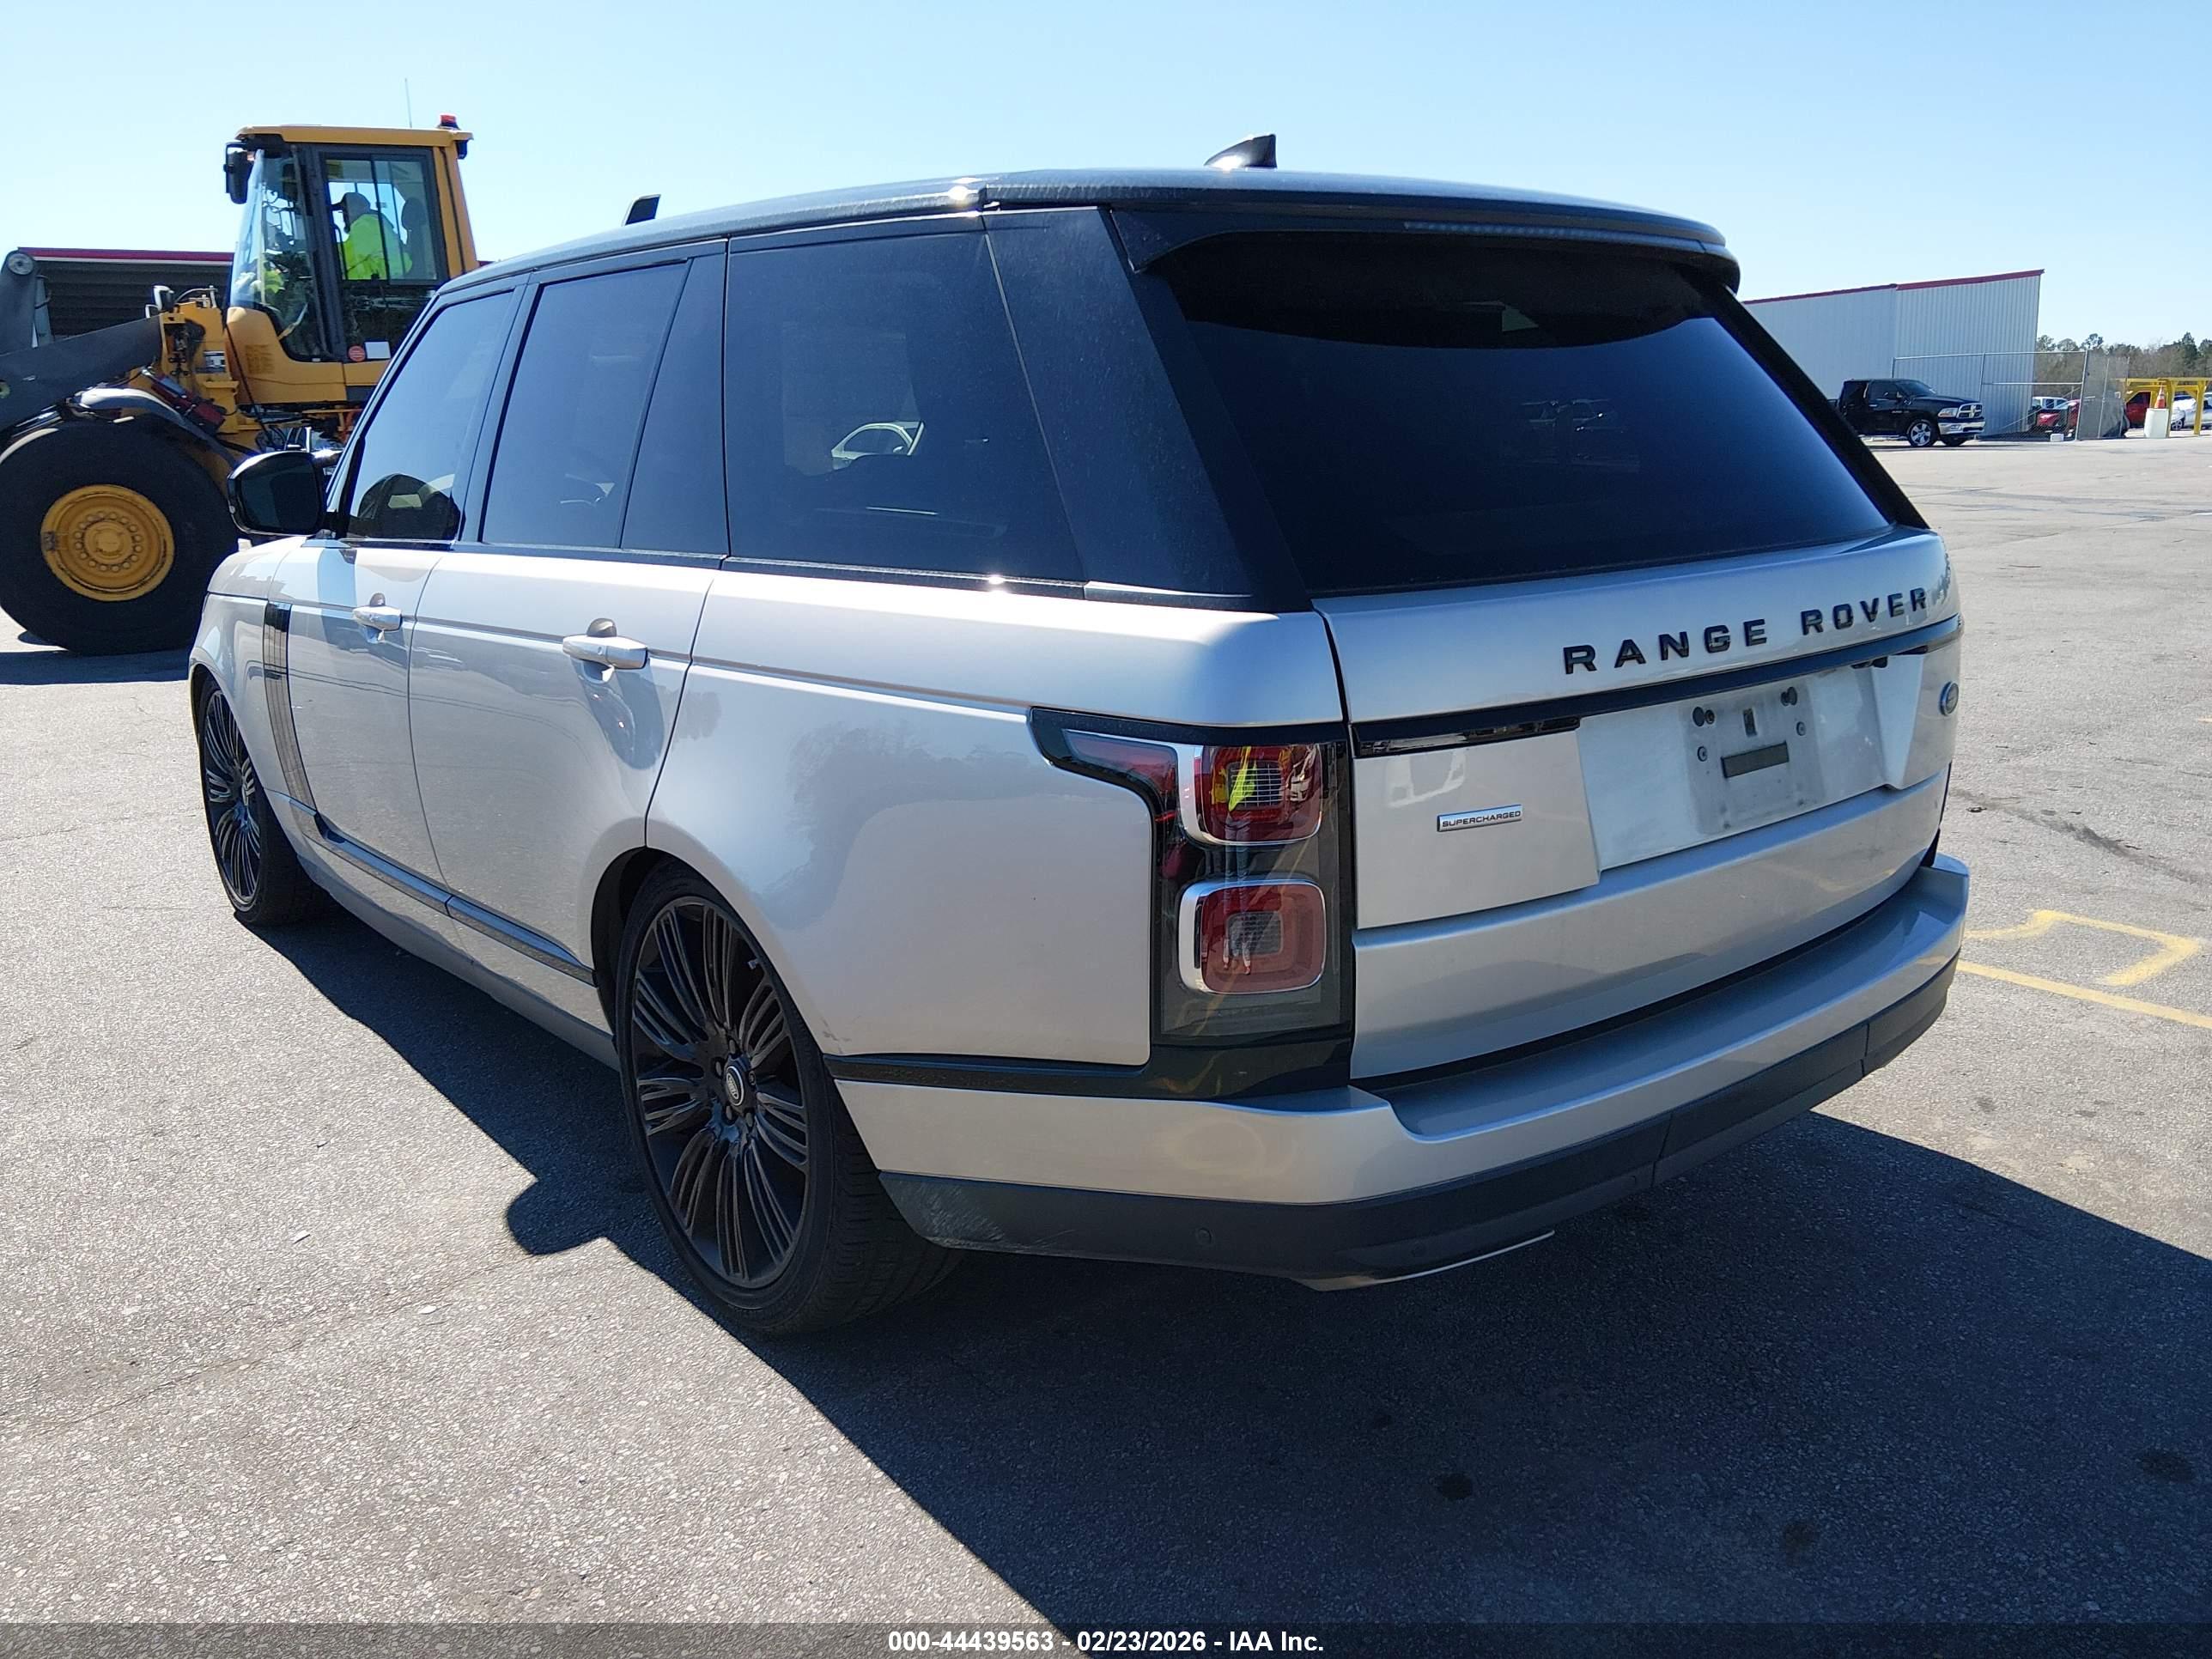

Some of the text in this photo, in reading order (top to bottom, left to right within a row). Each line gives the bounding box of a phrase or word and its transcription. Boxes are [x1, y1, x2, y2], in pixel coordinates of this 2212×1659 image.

[1562, 587, 1927, 675] RANGE ROVER
[1442, 810, 1522, 828] SUPERCHARGED
